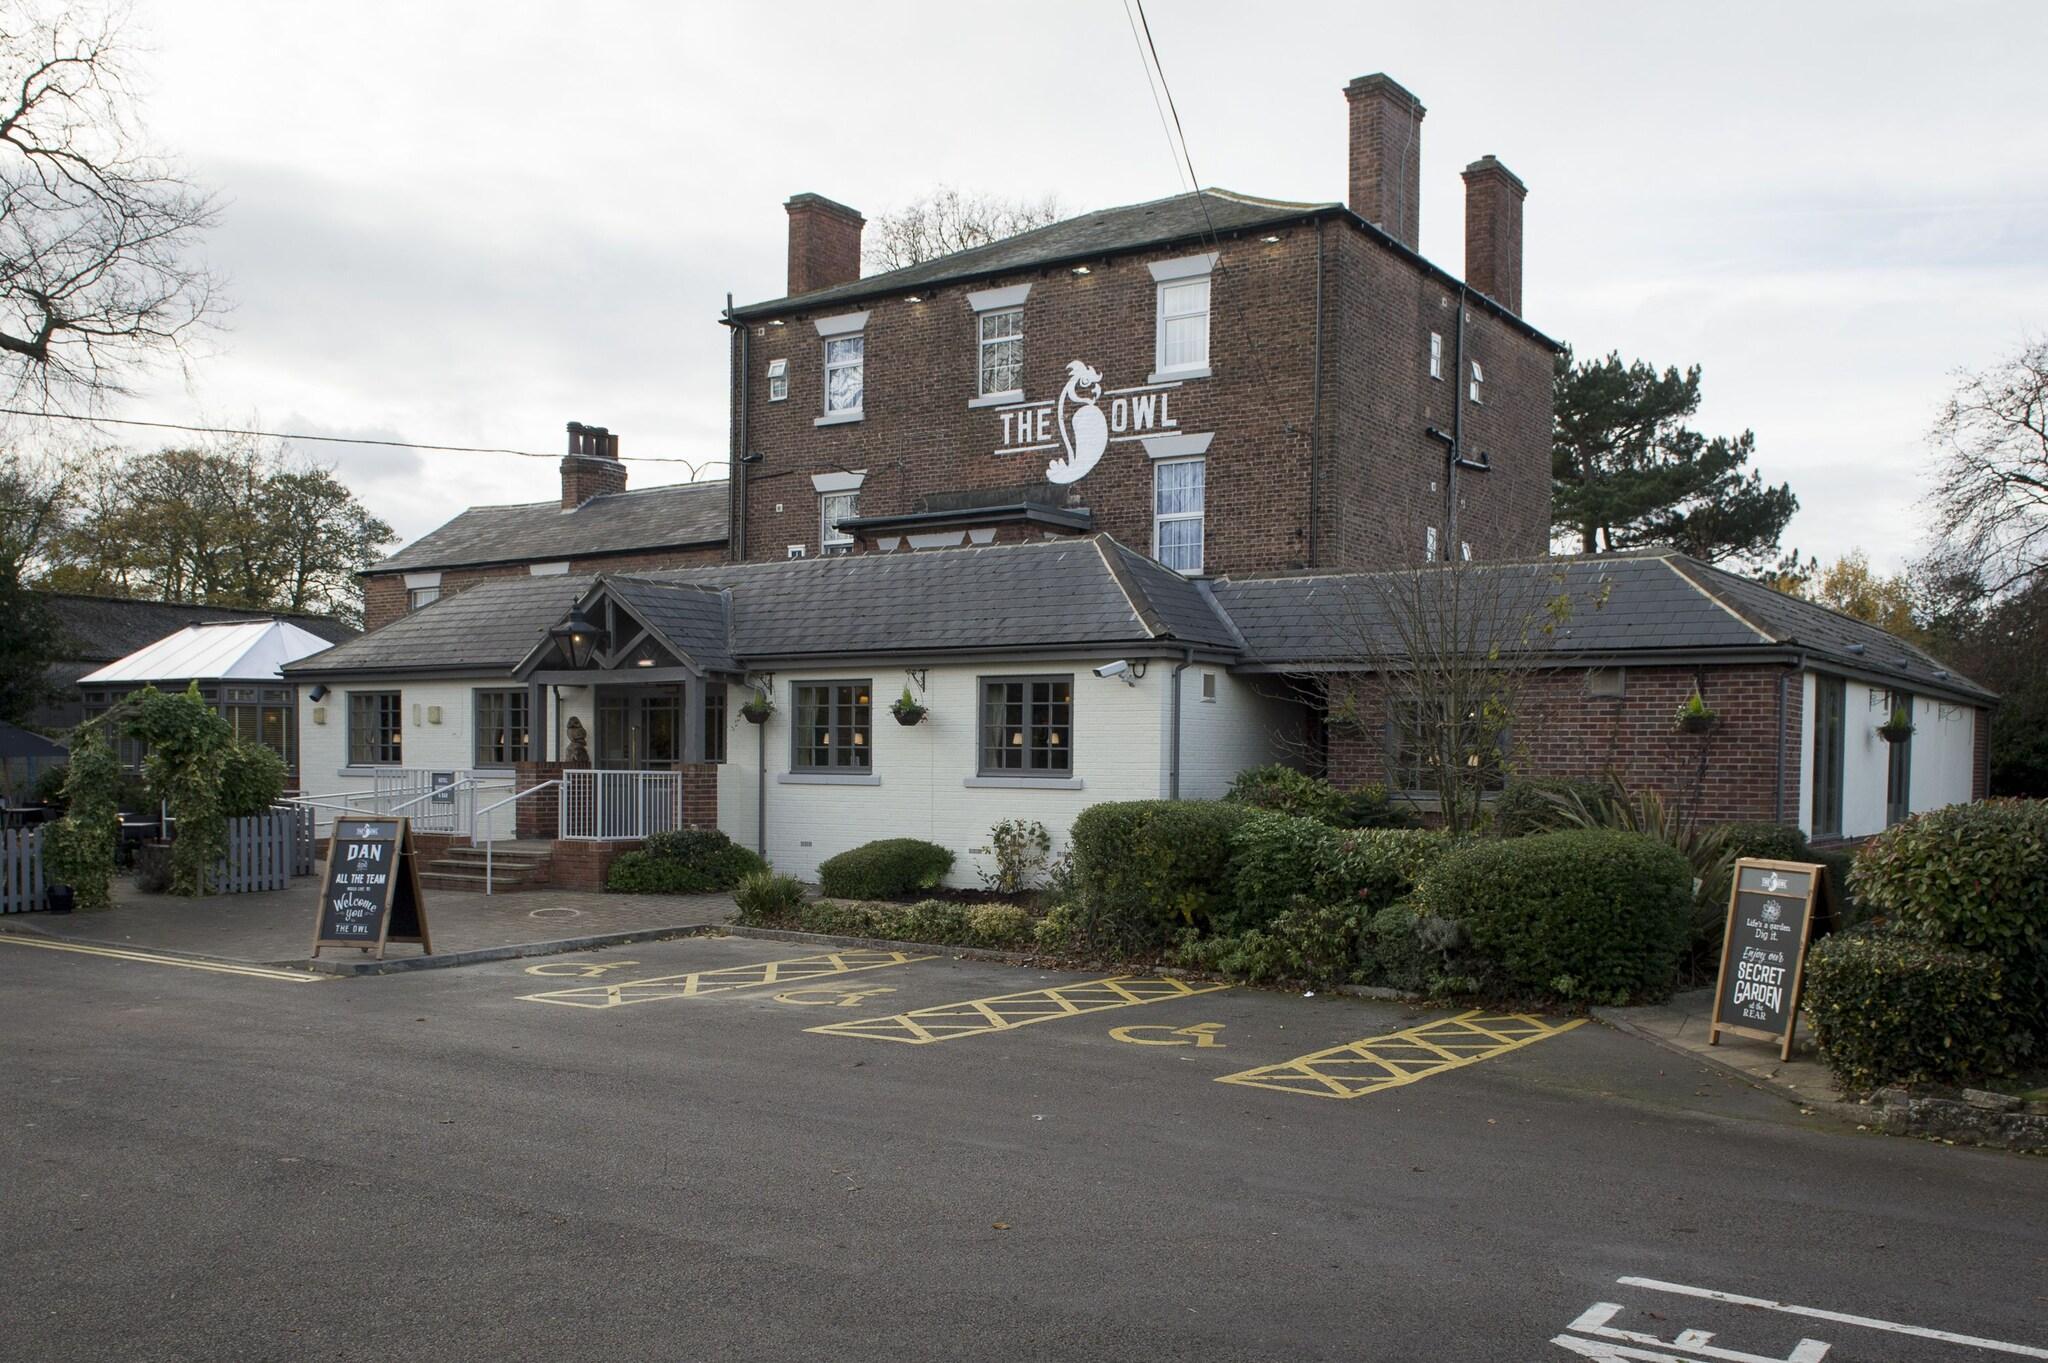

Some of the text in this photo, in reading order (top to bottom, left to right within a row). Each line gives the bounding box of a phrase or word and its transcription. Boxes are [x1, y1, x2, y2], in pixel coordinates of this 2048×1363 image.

[1000, 393, 1177, 445] THE OWL
[347, 844, 382, 862] DAN
[336, 874, 386, 884] ALL THE TEAM
[333, 892, 377, 913] Welcome
[345, 909, 363, 922] you
[1746, 917, 1763, 928] Life's
[335, 925, 369, 933] THE OWL
[1754, 928, 1768, 941] Dig
[1742, 946, 1784, 964] Enjoy our
[1737, 961, 1786, 986] SECRET
[1733, 980, 1783, 1014] GARDEN
[1742, 1008, 1766, 1021] REAR
